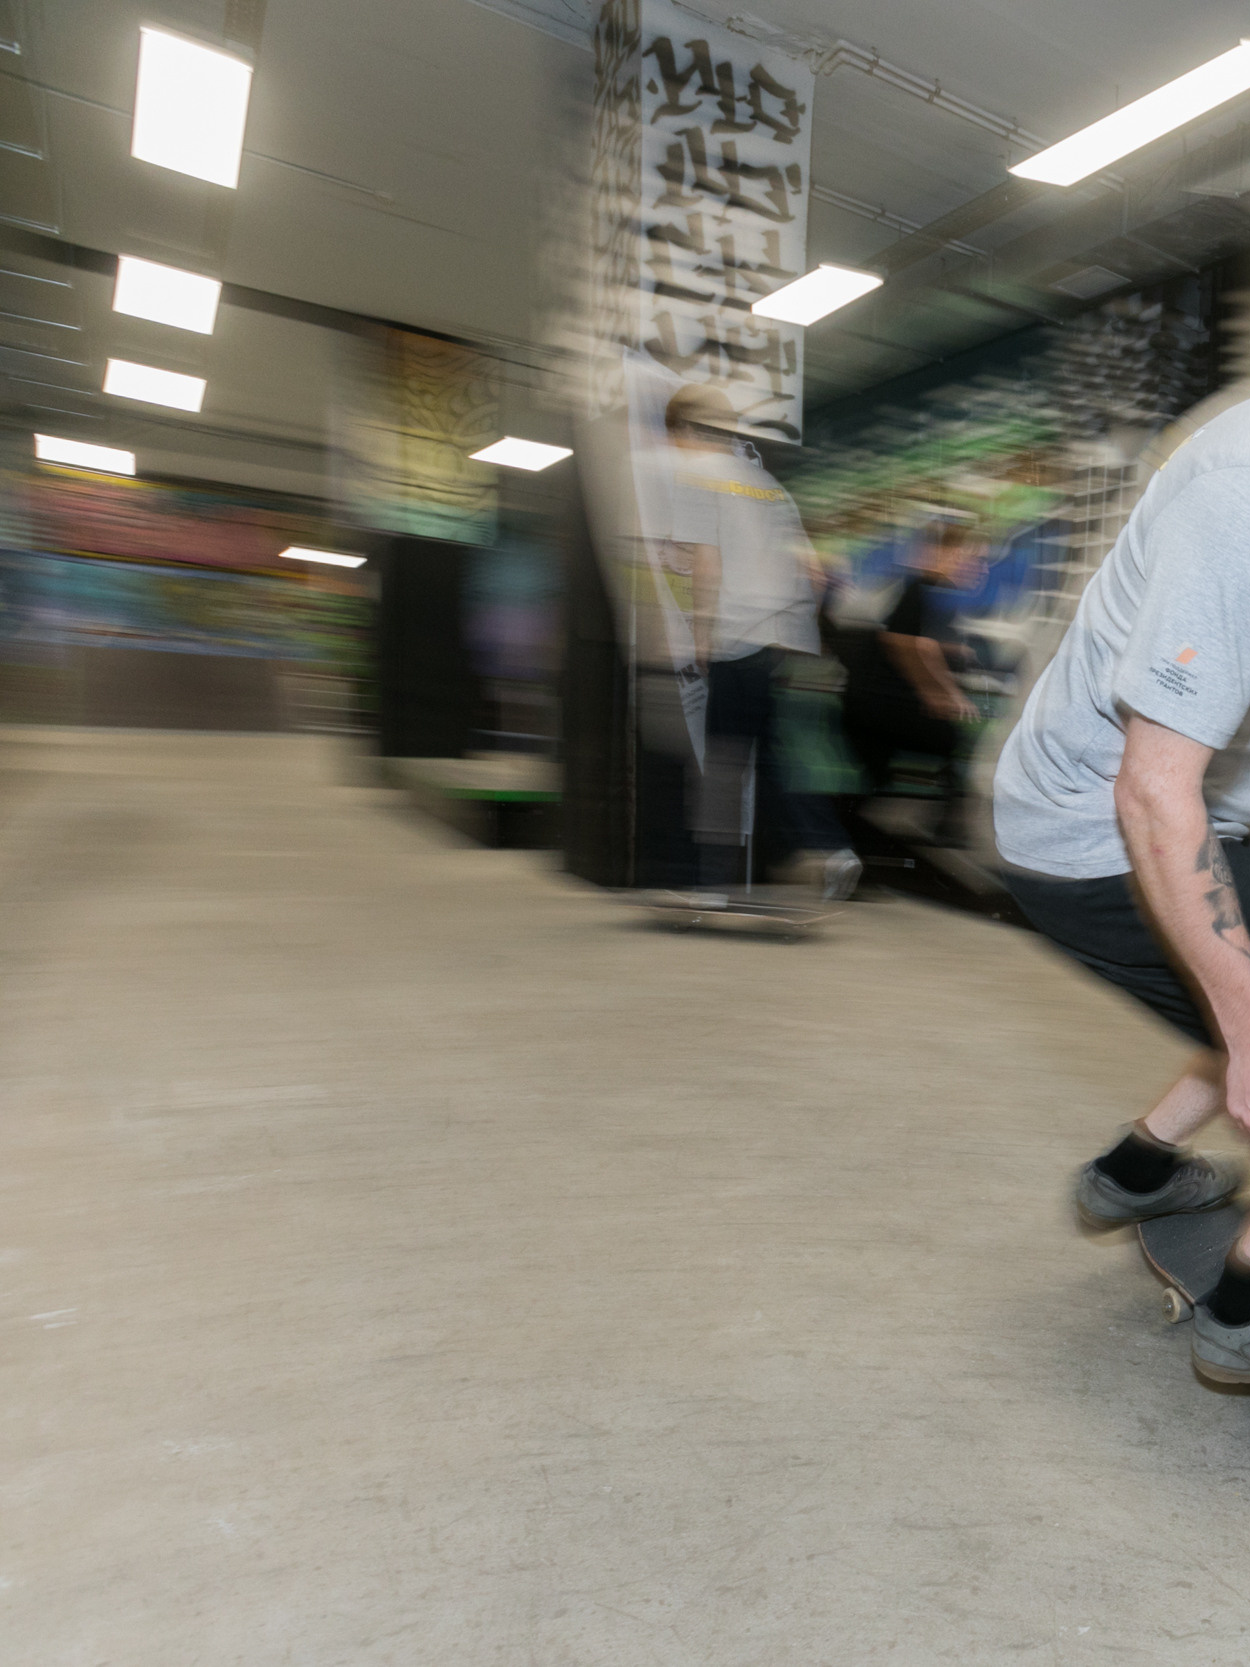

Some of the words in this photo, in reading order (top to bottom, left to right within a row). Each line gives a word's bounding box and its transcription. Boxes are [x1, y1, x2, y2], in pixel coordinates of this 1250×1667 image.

[1149, 666, 1198, 695] ПРЕЗИДЕНТСКИХ
[1165, 667, 1187, 683] ФОНДА
[1156, 678, 1183, 697] ГРАНТОВ
